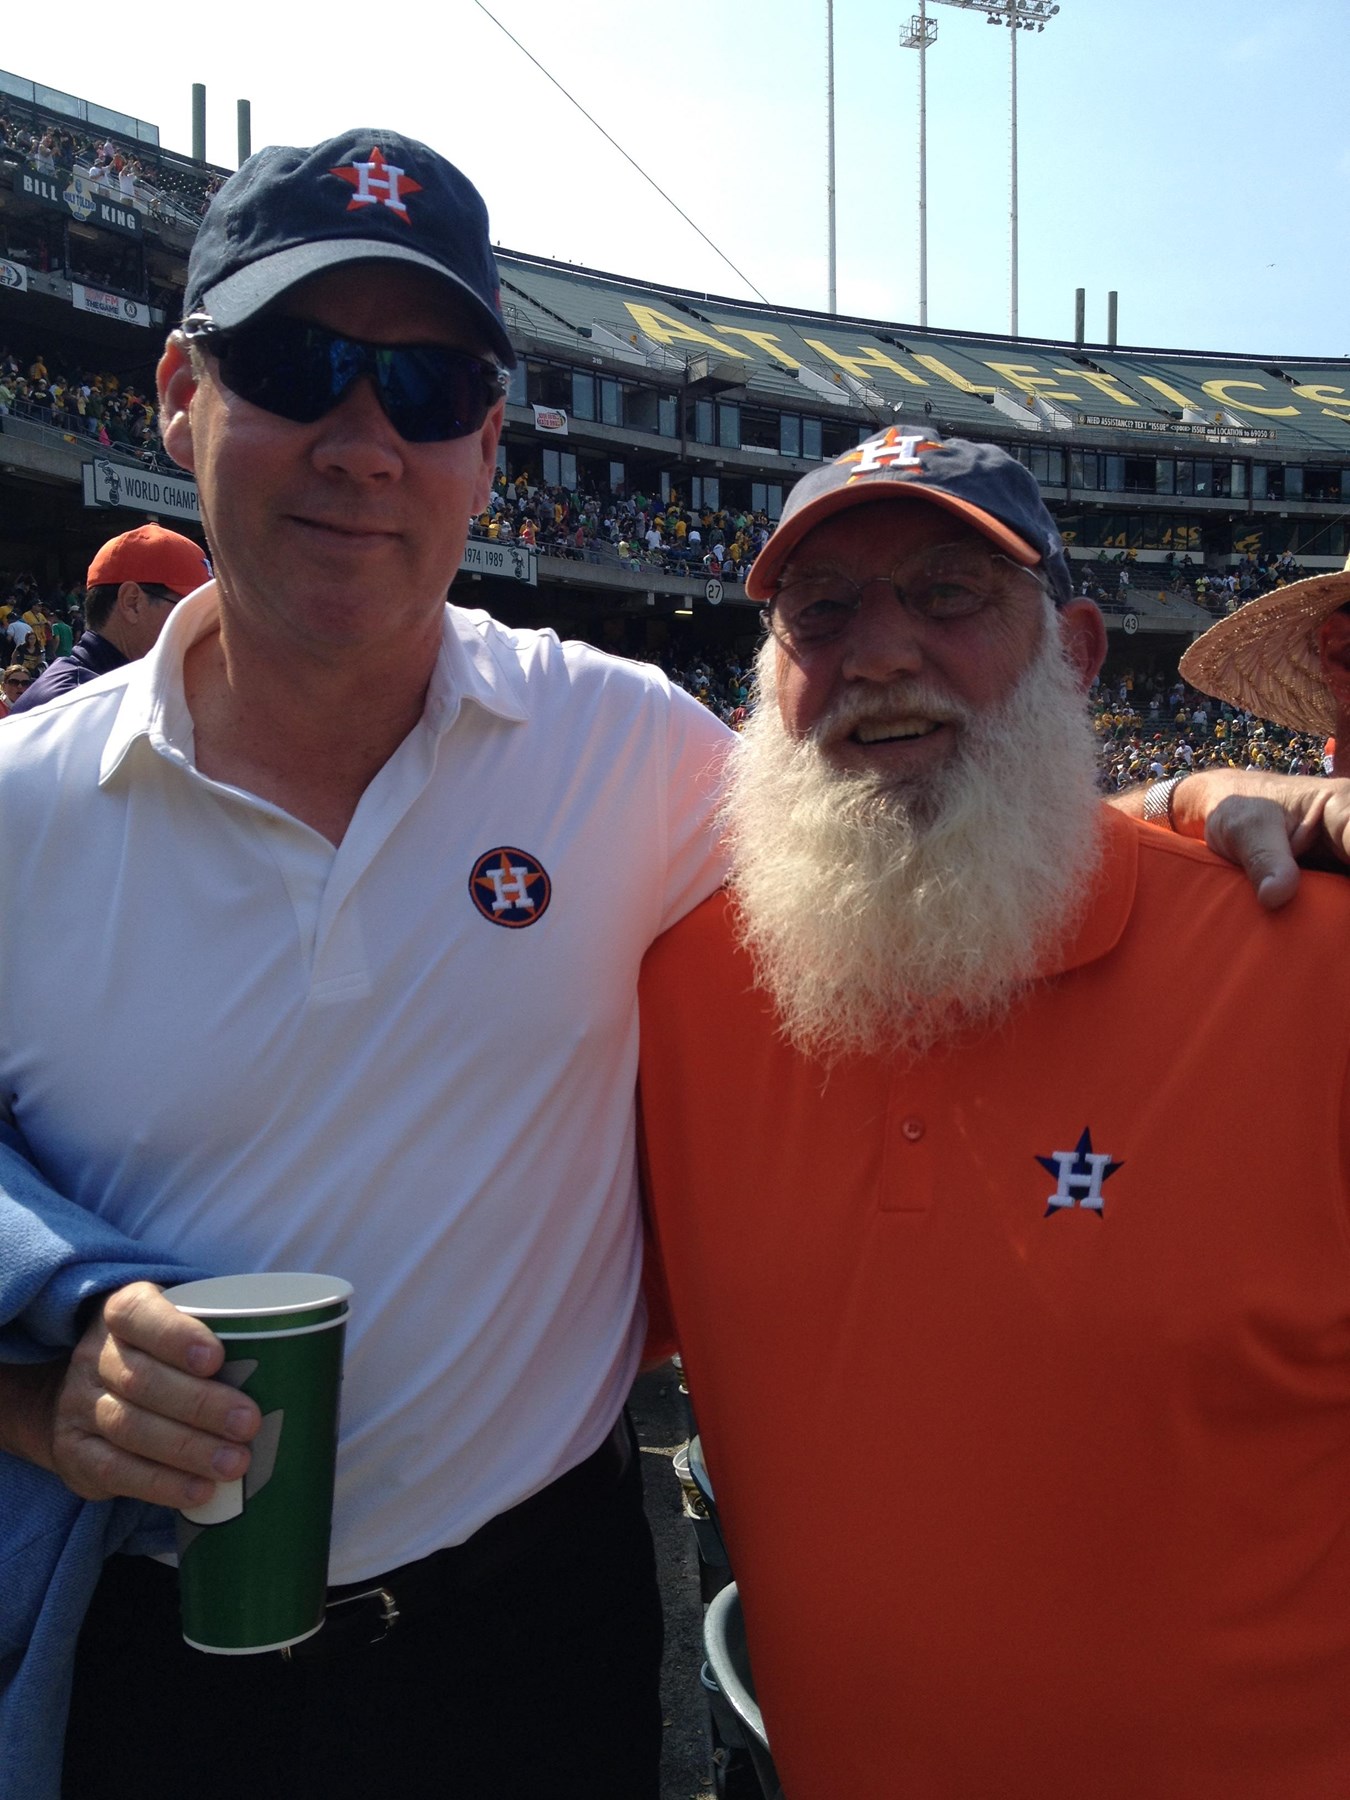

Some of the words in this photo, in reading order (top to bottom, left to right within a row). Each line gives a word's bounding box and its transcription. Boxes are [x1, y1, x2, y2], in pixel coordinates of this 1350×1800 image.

[23, 175, 58, 201] BILL
[101, 204, 136, 230] KING
[352, 161, 406, 211] H
[623, 301, 1350, 421] ATHLETICS
[1086, 415, 1101, 425] NEED
[1101, 417, 1134, 428] ASSISTANCE?
[1134, 421, 1147, 430] TEXT
[1191, 426, 1206, 434] ISSUE
[1206, 427, 1217, 435] and
[1217, 427, 1243, 437] LOCATION
[1250, 430, 1268, 438] 69050
[851, 435, 924, 472] H
[124, 476, 160, 502] WORLD
[464, 547, 481, 564] 1974
[485, 550, 504, 568] 1989
[708, 584, 721, 599] 27
[1125, 618, 1137, 630] 43
[486, 867, 535, 911] H
[1048, 1151, 1112, 1209] H
